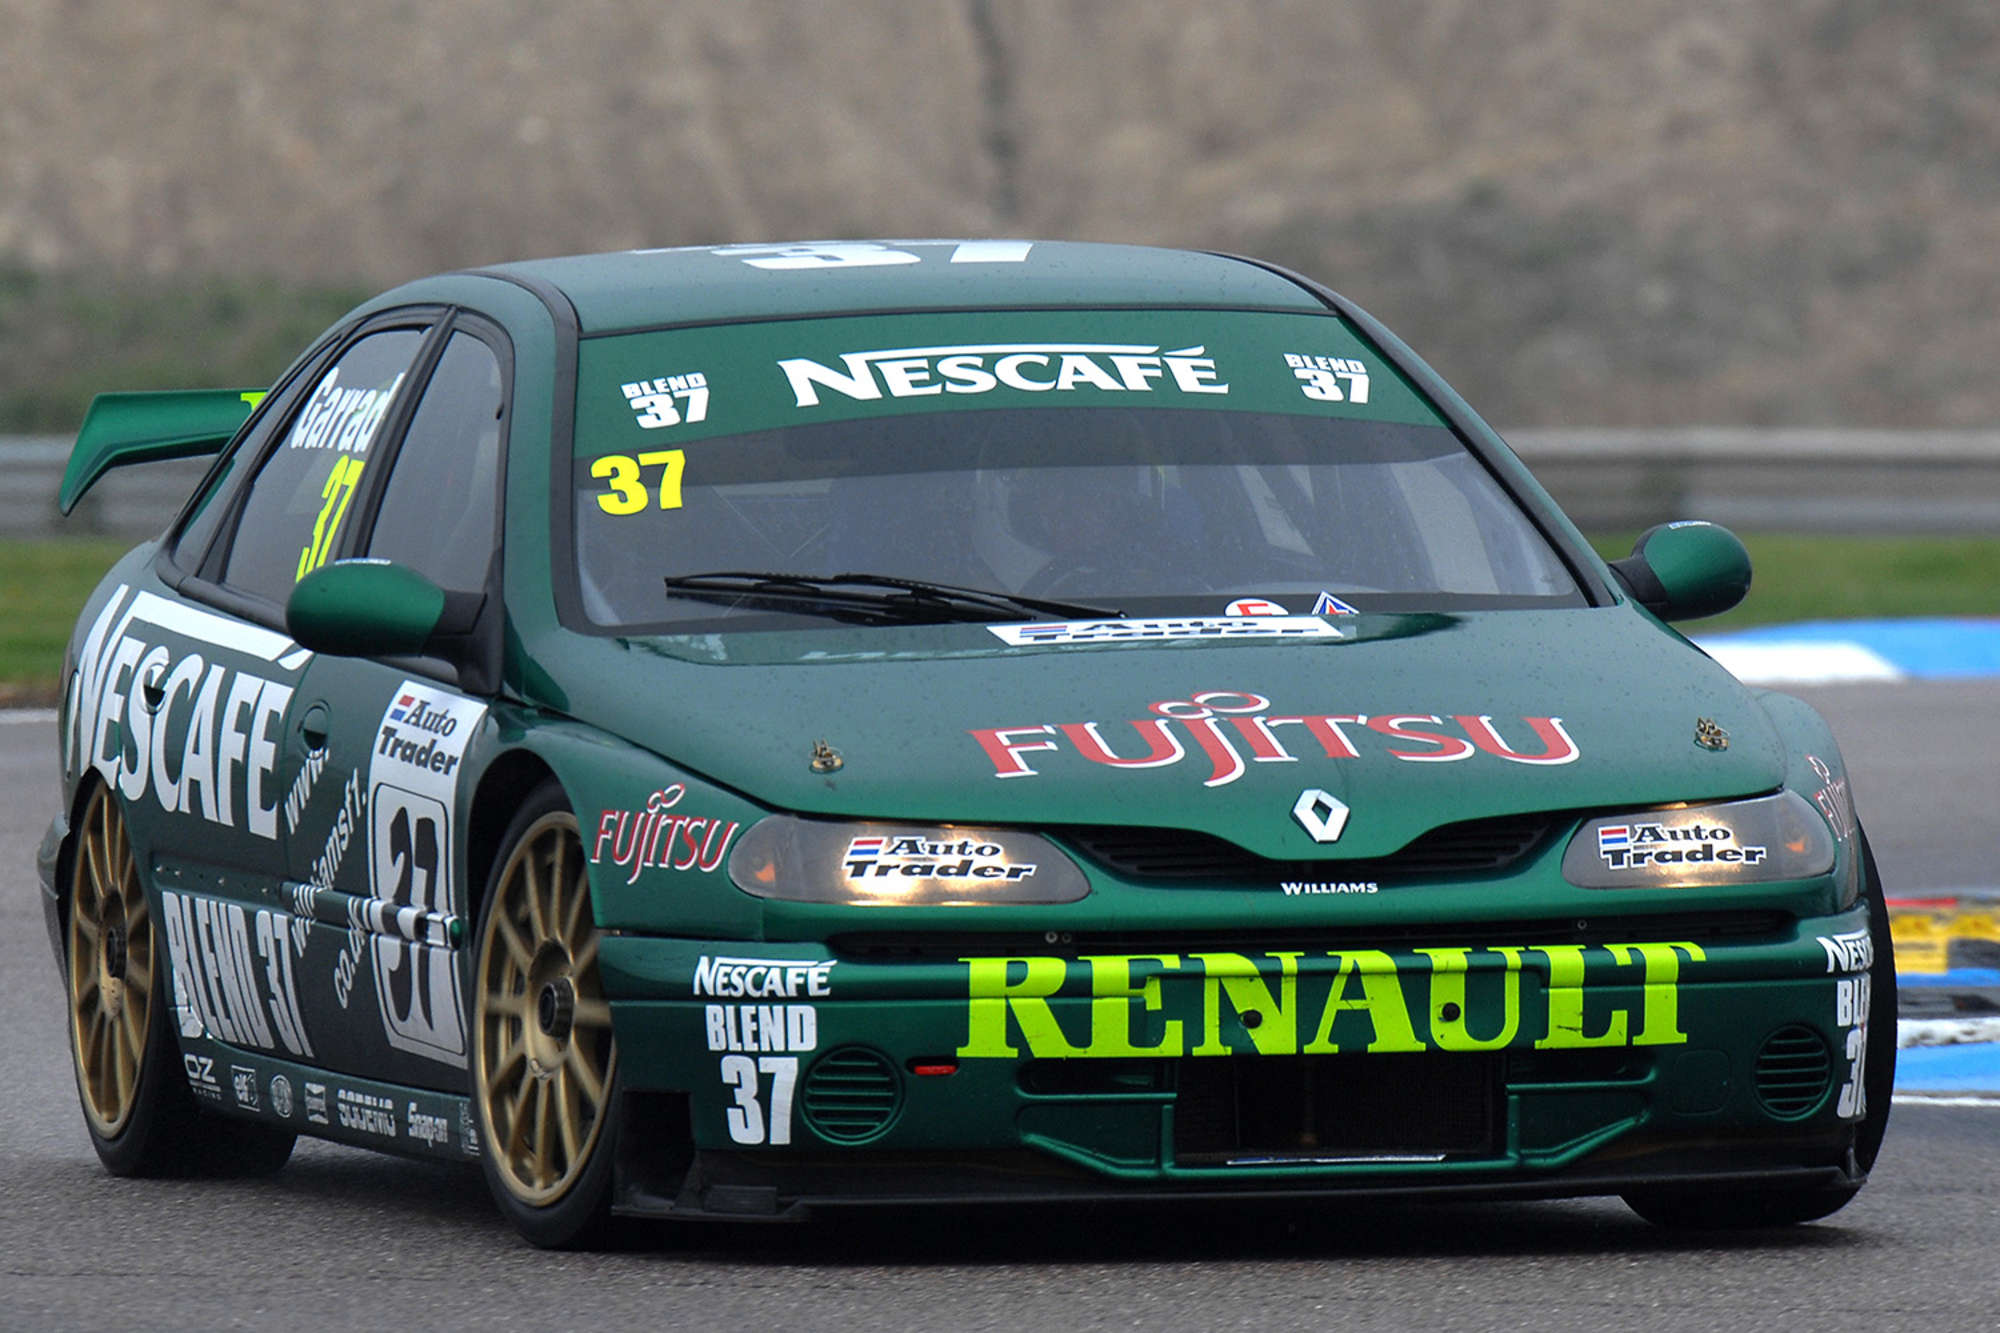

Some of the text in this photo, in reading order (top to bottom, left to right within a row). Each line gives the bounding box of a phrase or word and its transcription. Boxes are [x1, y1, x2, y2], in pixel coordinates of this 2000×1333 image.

[620, 372, 705, 398] BLEND
[777, 343, 1229, 407] NESCAFÉ
[1283, 353, 1367, 377] BLEND
[1291, 367, 1371, 404] 37
[291, 366, 405, 453] Garrad
[630, 388, 710, 429] 37
[590, 449, 686, 516] 37
[296, 454, 366, 583] 37
[403, 701, 457, 736] Auto
[966, 691, 1580, 787] FUJITSU
[380, 726, 458, 775] Trader
[591, 783, 739, 884] FUJITSU
[886, 837, 1002, 858] Auto
[1633, 824, 1731, 844] Auto
[845, 858, 1035, 881] Trader
[1602, 846, 1766, 868] Trader
[1280, 882, 1378, 896] WILLIAMS
[162, 891, 315, 1058] BLEND 37
[956, 941, 1706, 1059] RENAULT
[705, 1005, 818, 1052] BLEND
[185, 1054, 216, 1083] OZ
[721, 1055, 799, 1145] 37
